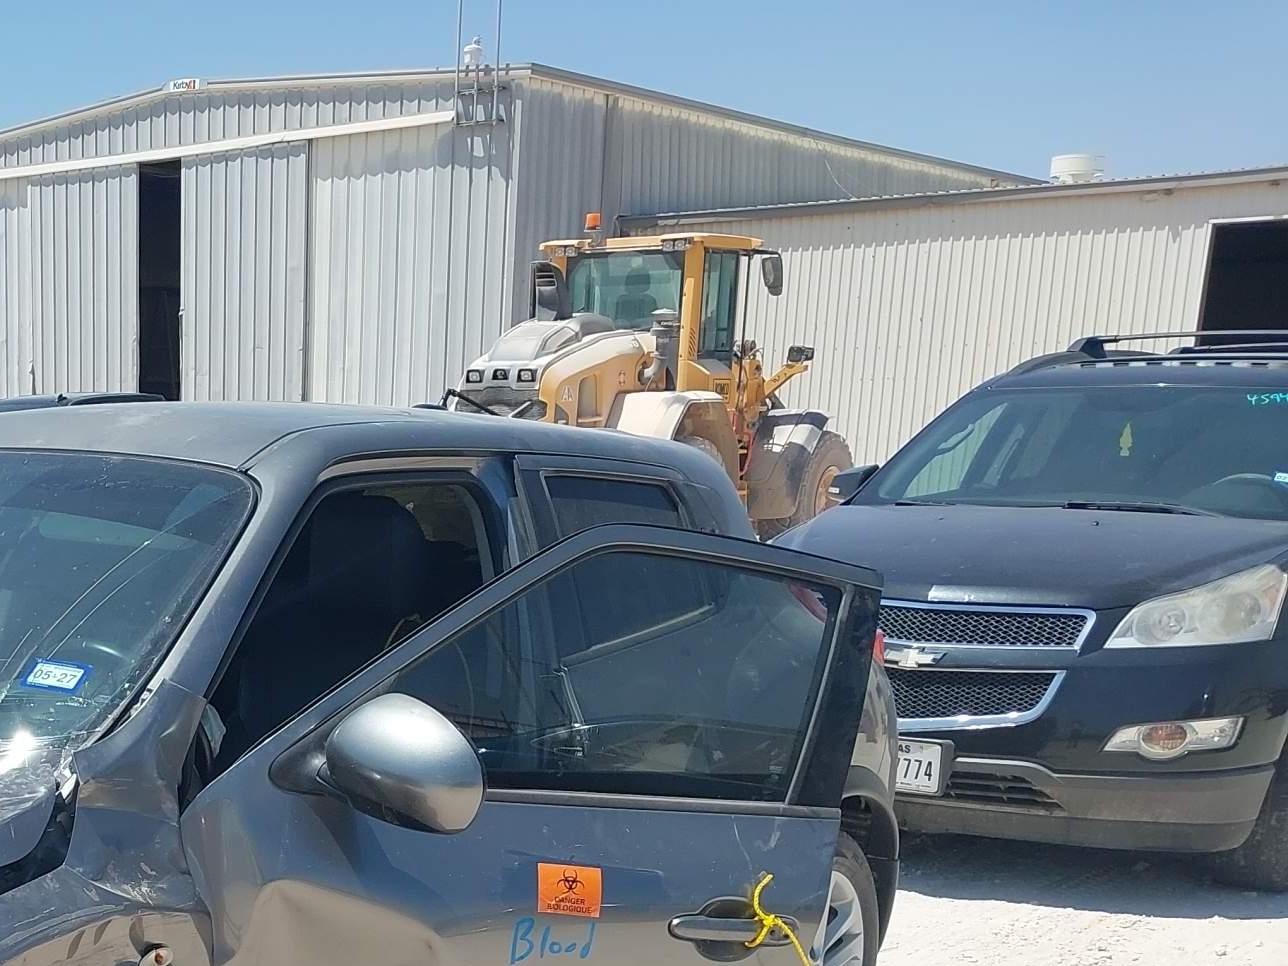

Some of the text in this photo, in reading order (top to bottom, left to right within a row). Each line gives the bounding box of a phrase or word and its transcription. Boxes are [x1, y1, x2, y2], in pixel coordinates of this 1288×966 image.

[897, 757, 933, 782] 774
[547, 903, 593, 914] BIOLOGIQUE
[554, 896, 586, 906] DANGER
[510, 917, 596, 965] Blood
